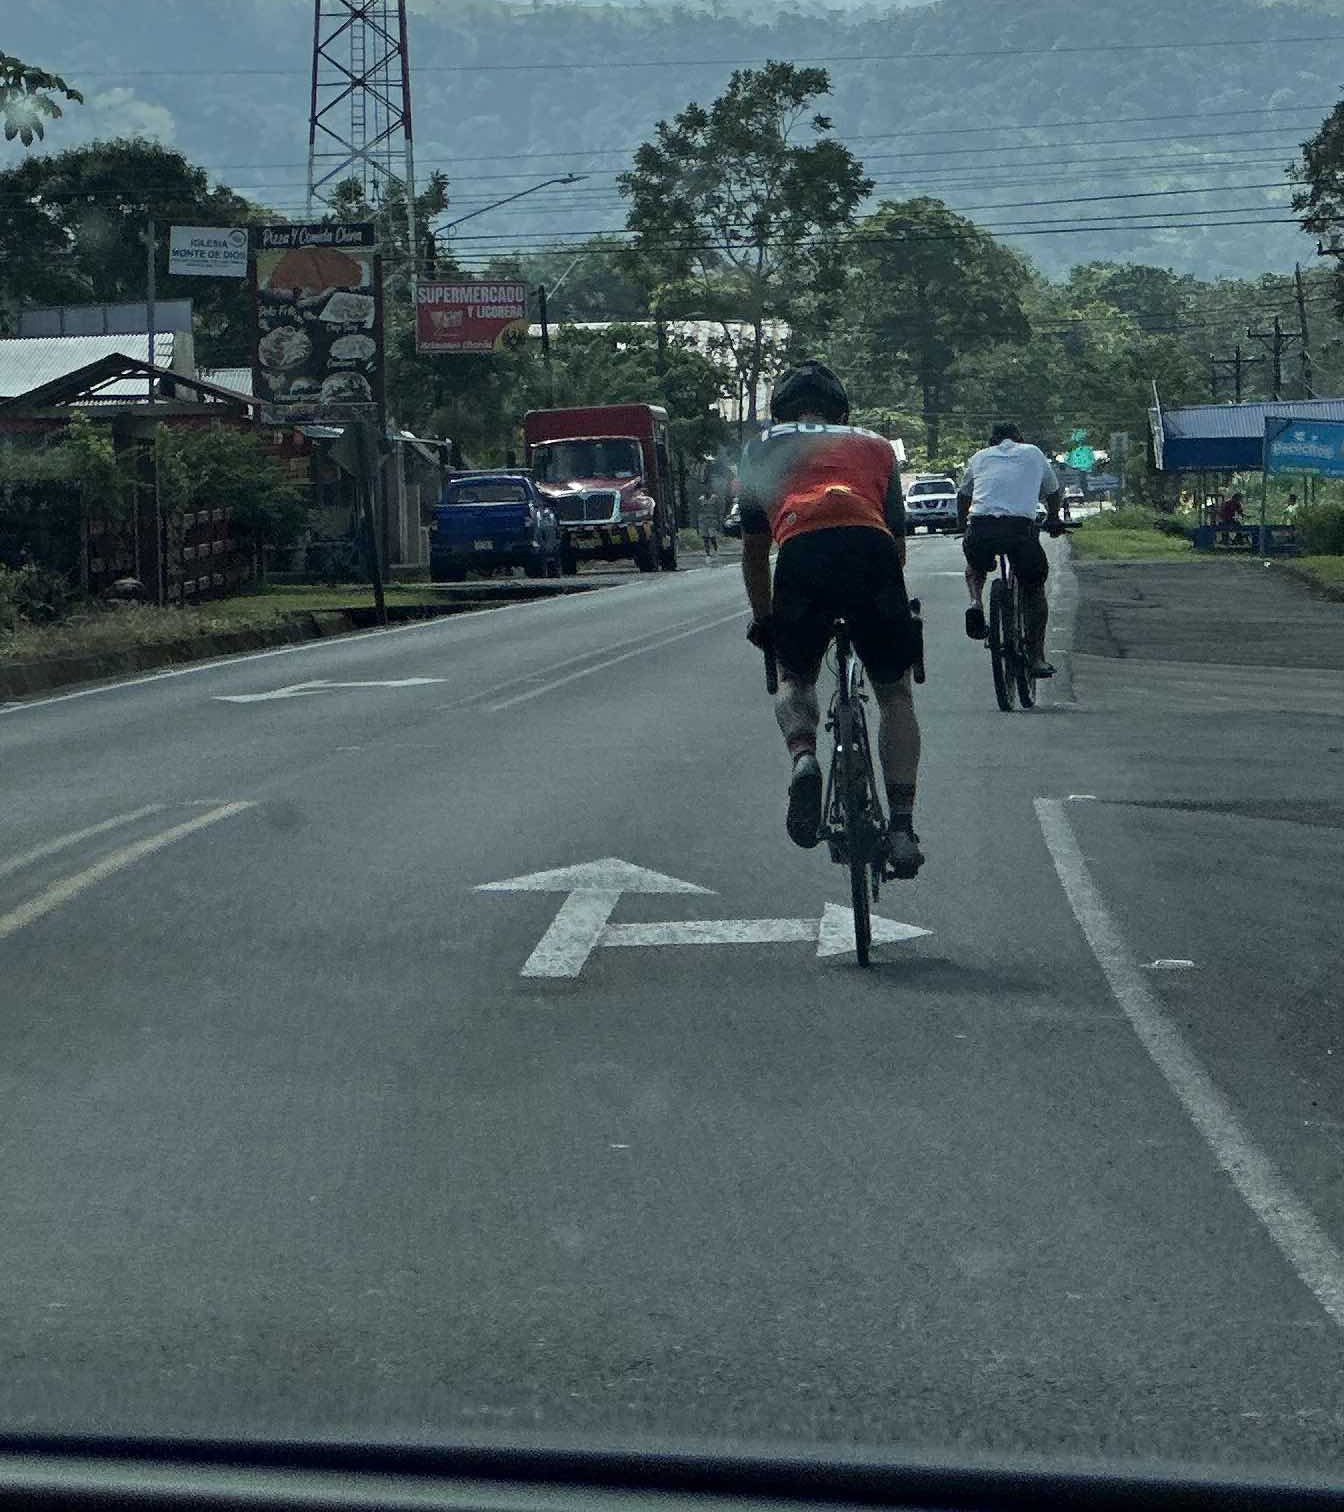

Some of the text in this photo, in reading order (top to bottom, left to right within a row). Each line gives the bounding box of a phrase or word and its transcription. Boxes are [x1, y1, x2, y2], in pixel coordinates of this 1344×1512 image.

[190, 239, 228, 249] IGLESIA
[172, 249, 207, 259] MONTE
[418, 285, 524, 304] SUPERMERCADO
[467, 305, 474, 318] Y
